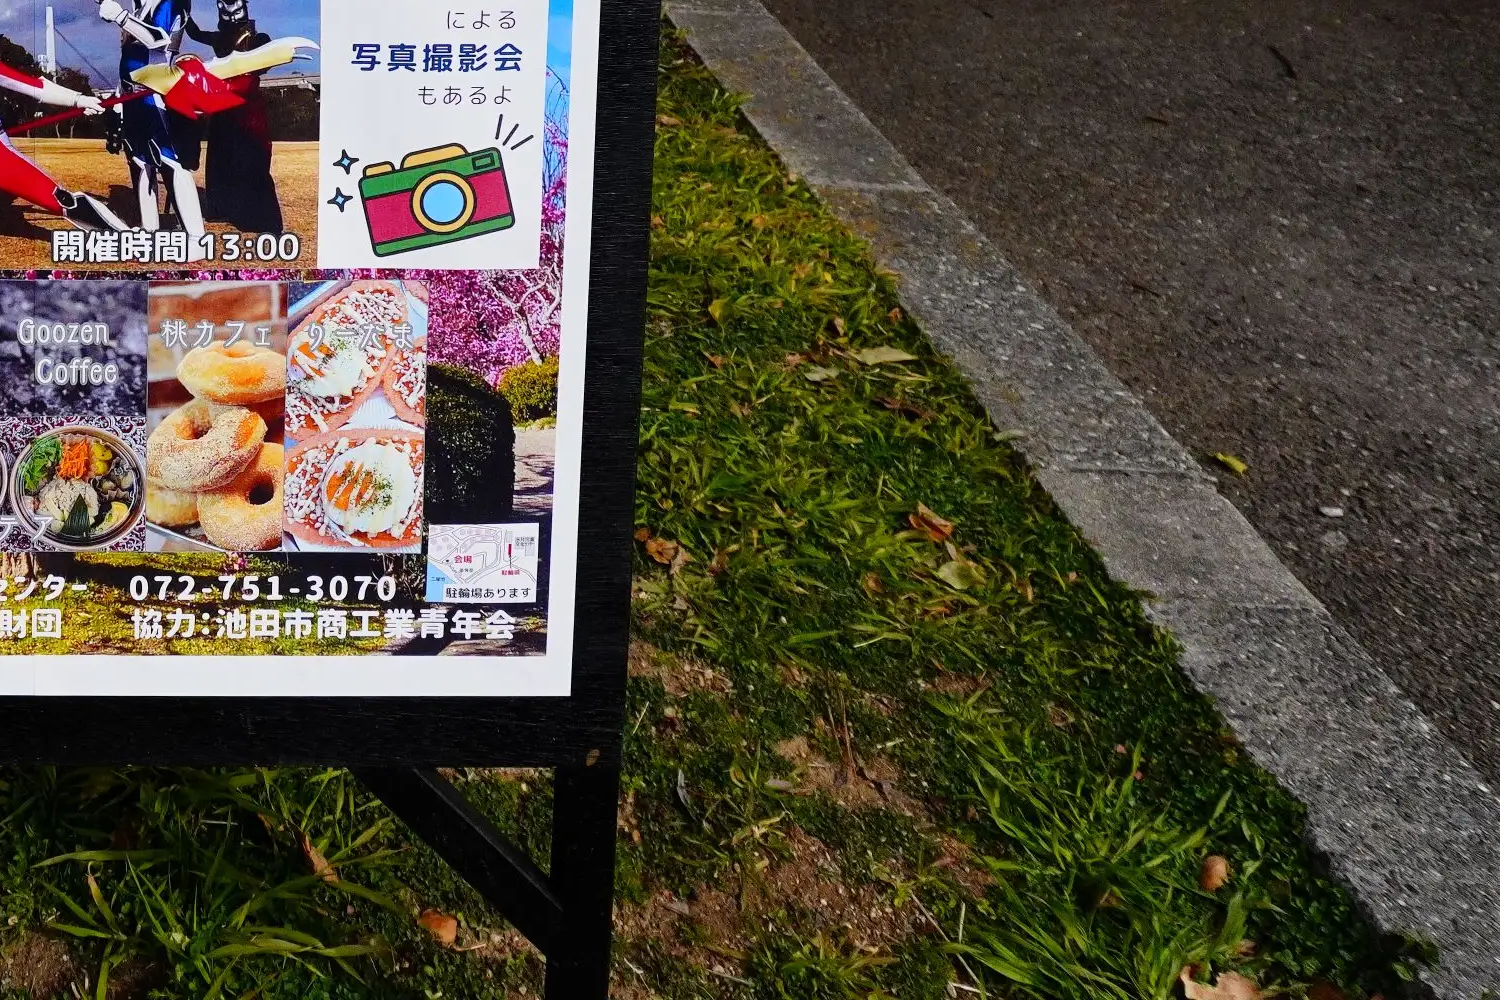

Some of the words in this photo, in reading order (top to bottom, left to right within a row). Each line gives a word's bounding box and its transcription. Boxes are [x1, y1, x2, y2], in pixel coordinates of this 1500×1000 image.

[446, 9, 517, 30] による
[350, 42, 523, 73] 写真撮影会
[417, 85, 512, 105] もあるよ
[51, 229, 189, 265] 開催時間
[196, 230, 301, 263] 13:00
[18, 316, 111, 346] Goozen
[160, 319, 273, 350] 桃カフェ
[307, 320, 414, 352] りーたま
[34, 356, 120, 386] Coffee
[129, 574, 398, 602] 072-751-3070
[445, 587, 531, 599] 駐輪場あります
